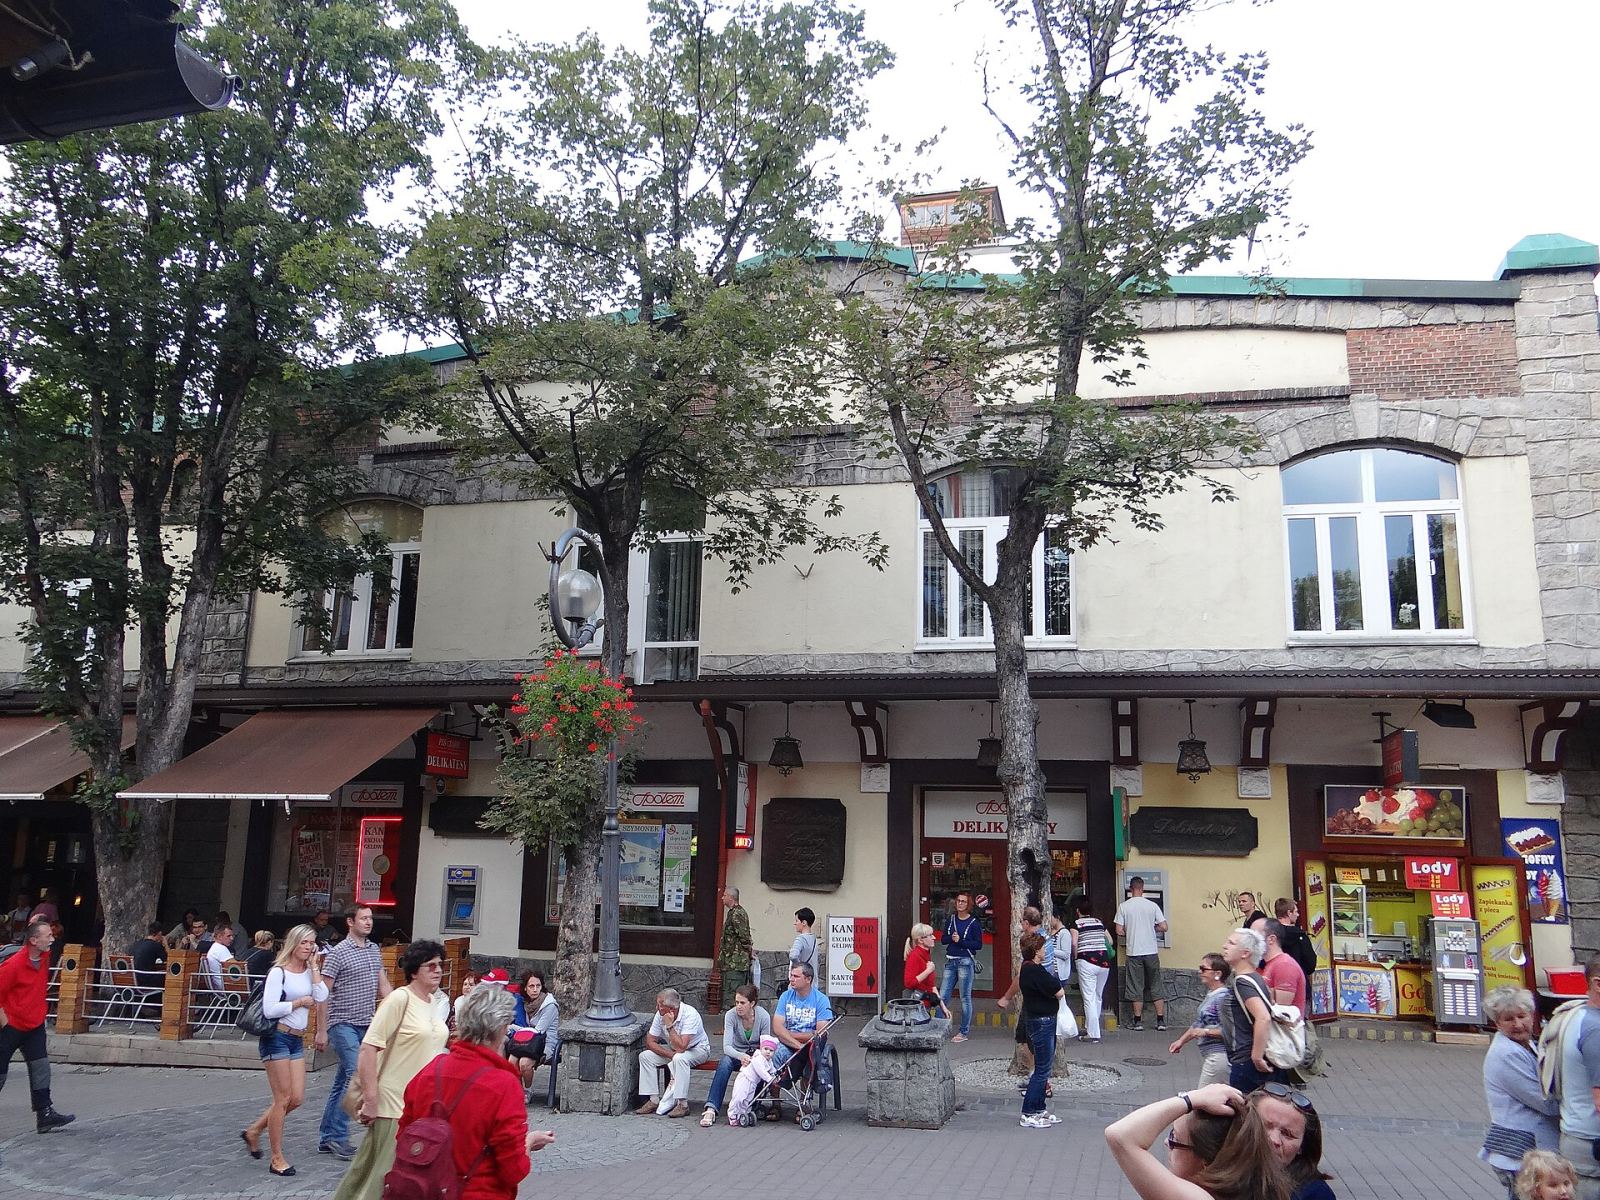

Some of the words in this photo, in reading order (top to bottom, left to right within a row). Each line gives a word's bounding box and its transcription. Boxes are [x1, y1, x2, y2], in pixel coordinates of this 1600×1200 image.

[427, 755, 467, 770] DELIKATESY
[953, 821, 1058, 834] DELIKY
[1411, 861, 1451, 876] Lody
[1435, 894, 1464, 904] Lody
[832, 925, 874, 933] KANTOR
[1341, 972, 1381, 986] LODY
